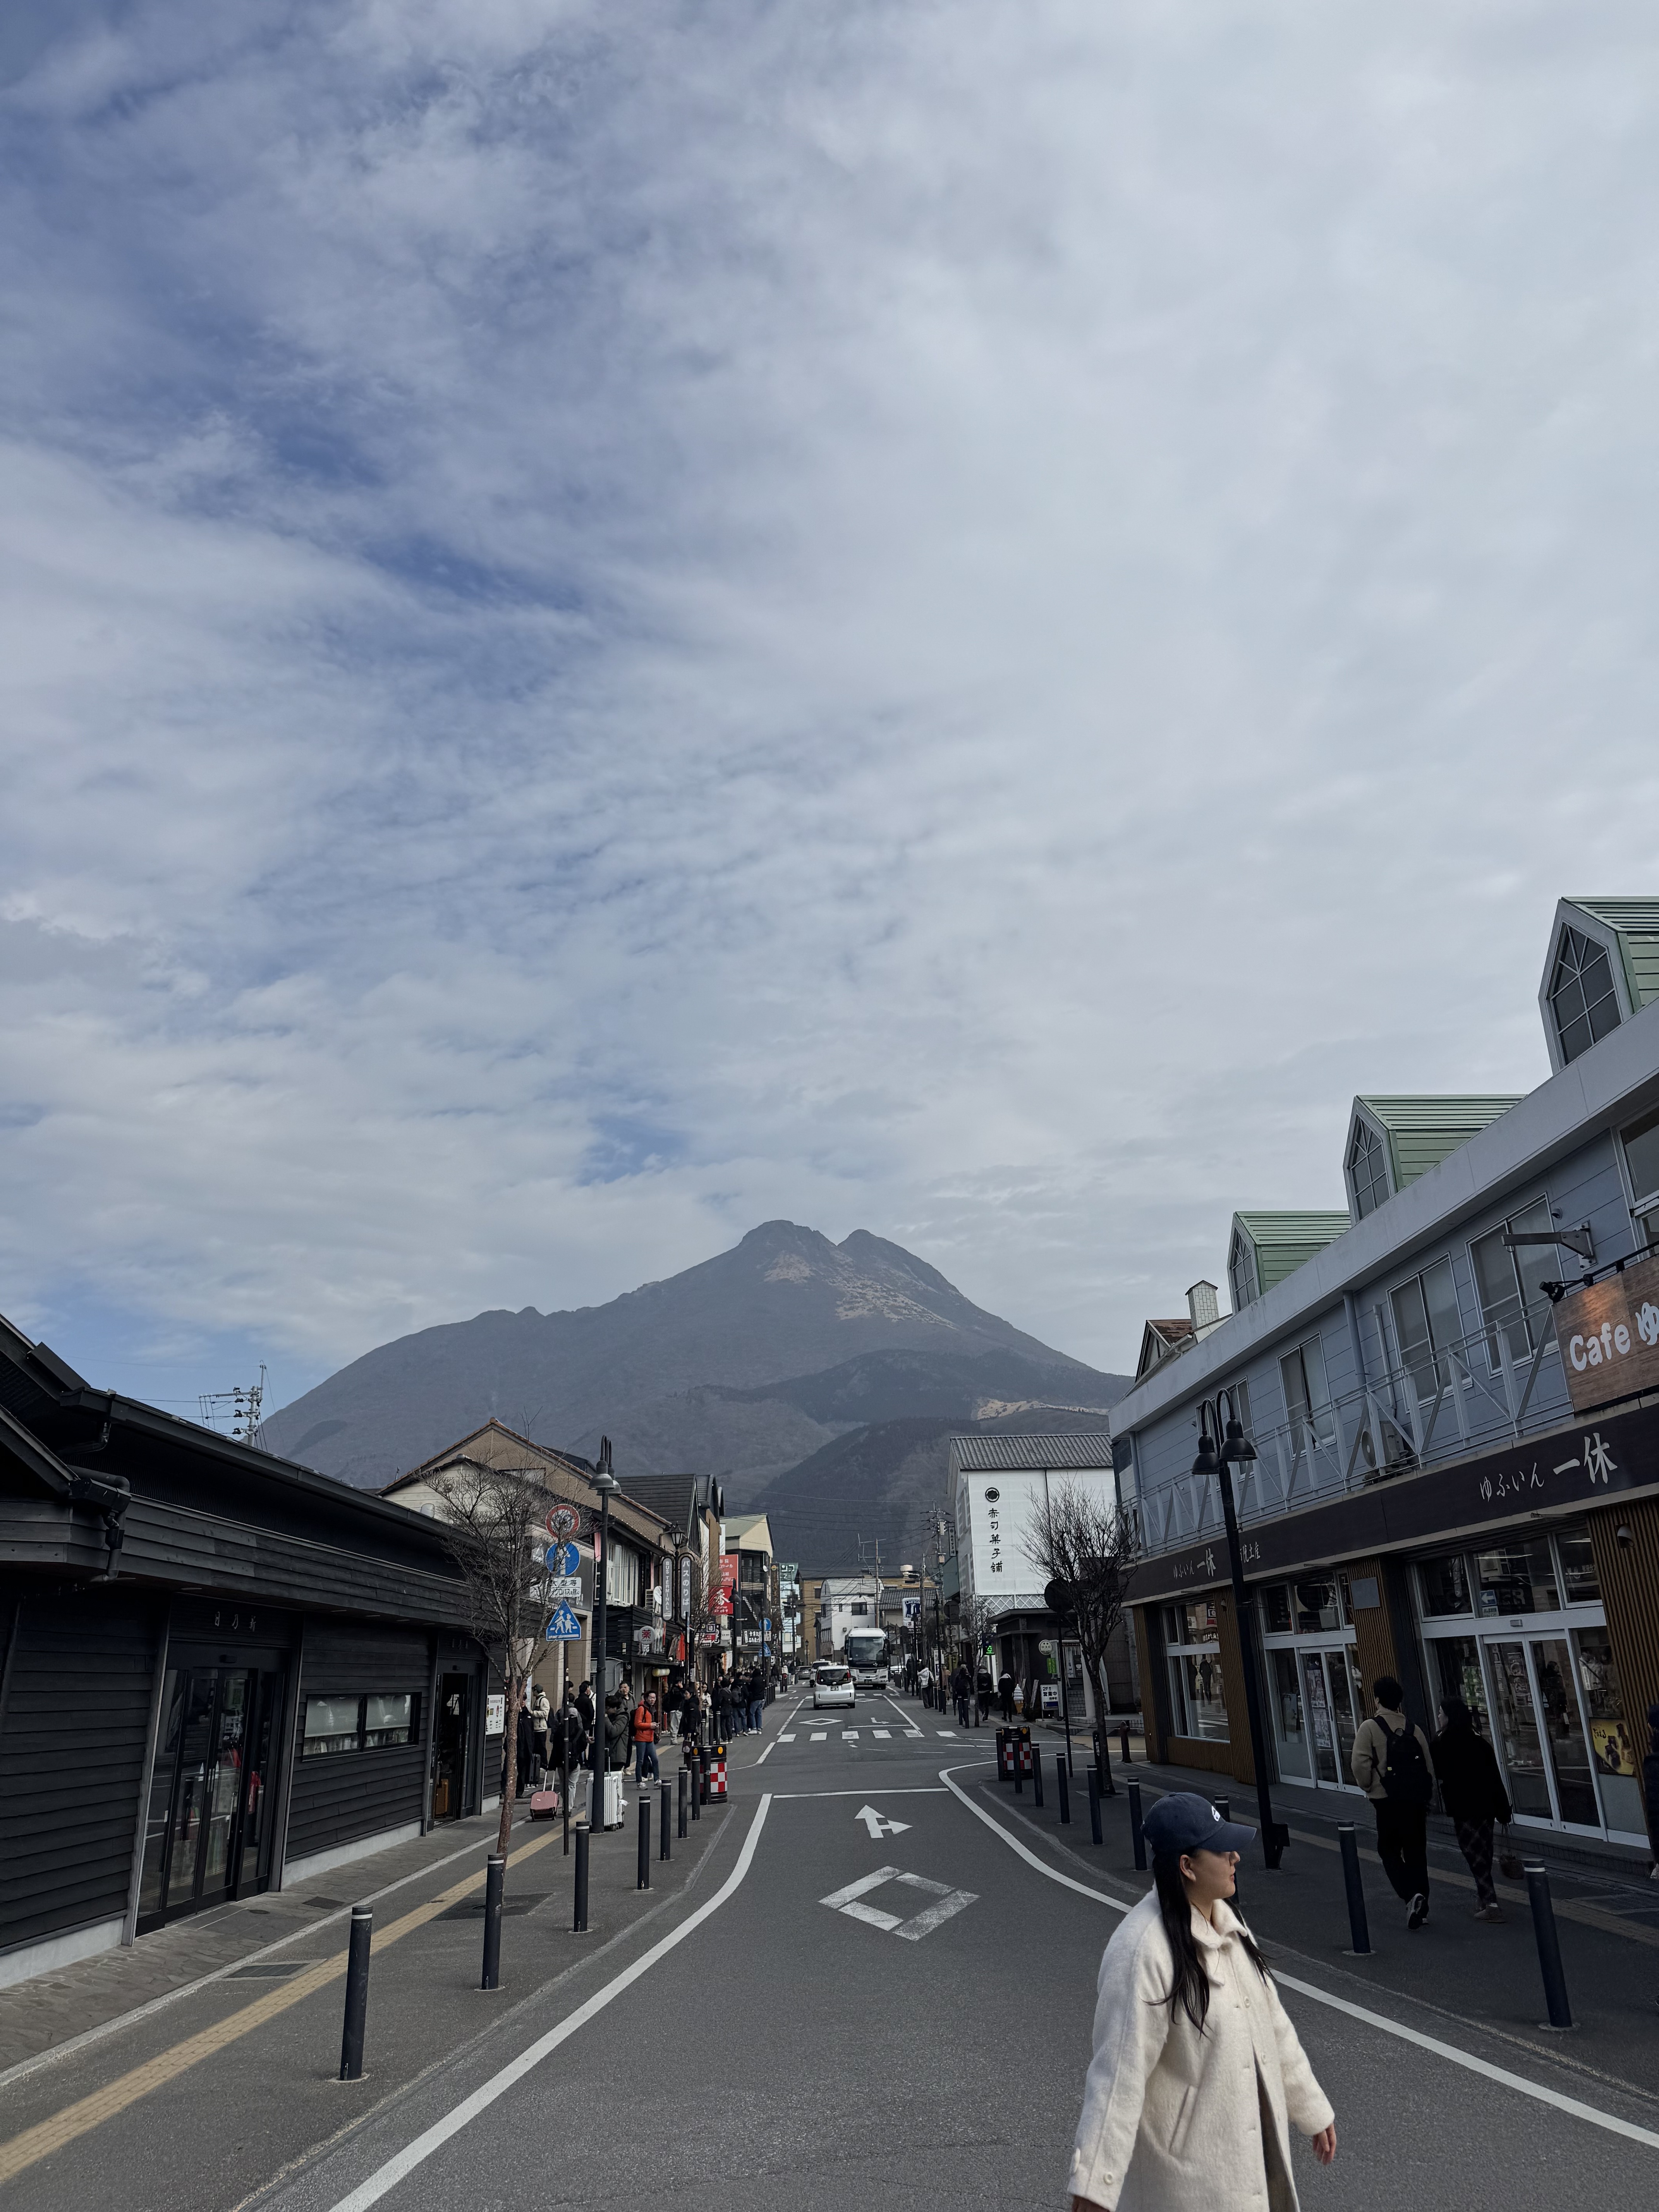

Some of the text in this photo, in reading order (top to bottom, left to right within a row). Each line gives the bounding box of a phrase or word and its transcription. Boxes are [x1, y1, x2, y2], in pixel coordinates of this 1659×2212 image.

[1570, 1322, 1630, 1371] Cafe
[1480, 1433, 1618, 1502] ゆふいん 一休
[988, 1508, 1003, 1573] 赤司菓子舗
[1173, 1548, 1216, 1579] ゆふいん 一休
[642, 1630, 651, 1639] 薬
